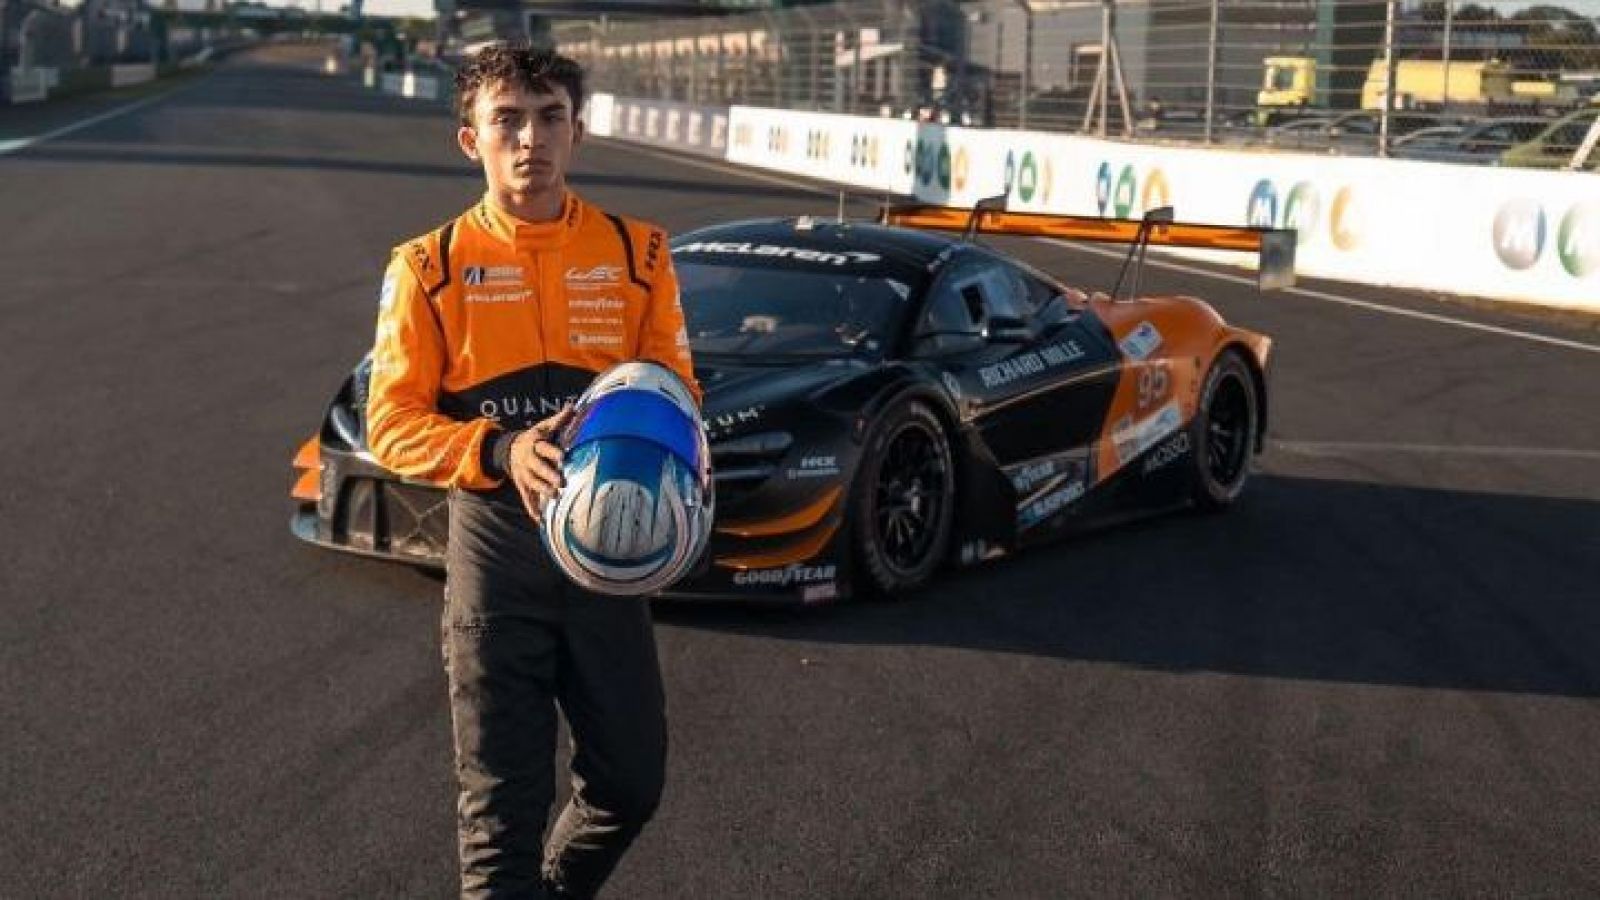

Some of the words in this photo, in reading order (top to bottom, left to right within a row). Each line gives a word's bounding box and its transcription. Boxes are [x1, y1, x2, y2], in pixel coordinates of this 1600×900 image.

[671, 242, 848, 265] McLaren
[978, 353, 1046, 389] RICHARD
[1040, 340, 1085, 366] MILLE
[1137, 366, 1168, 409] 95
